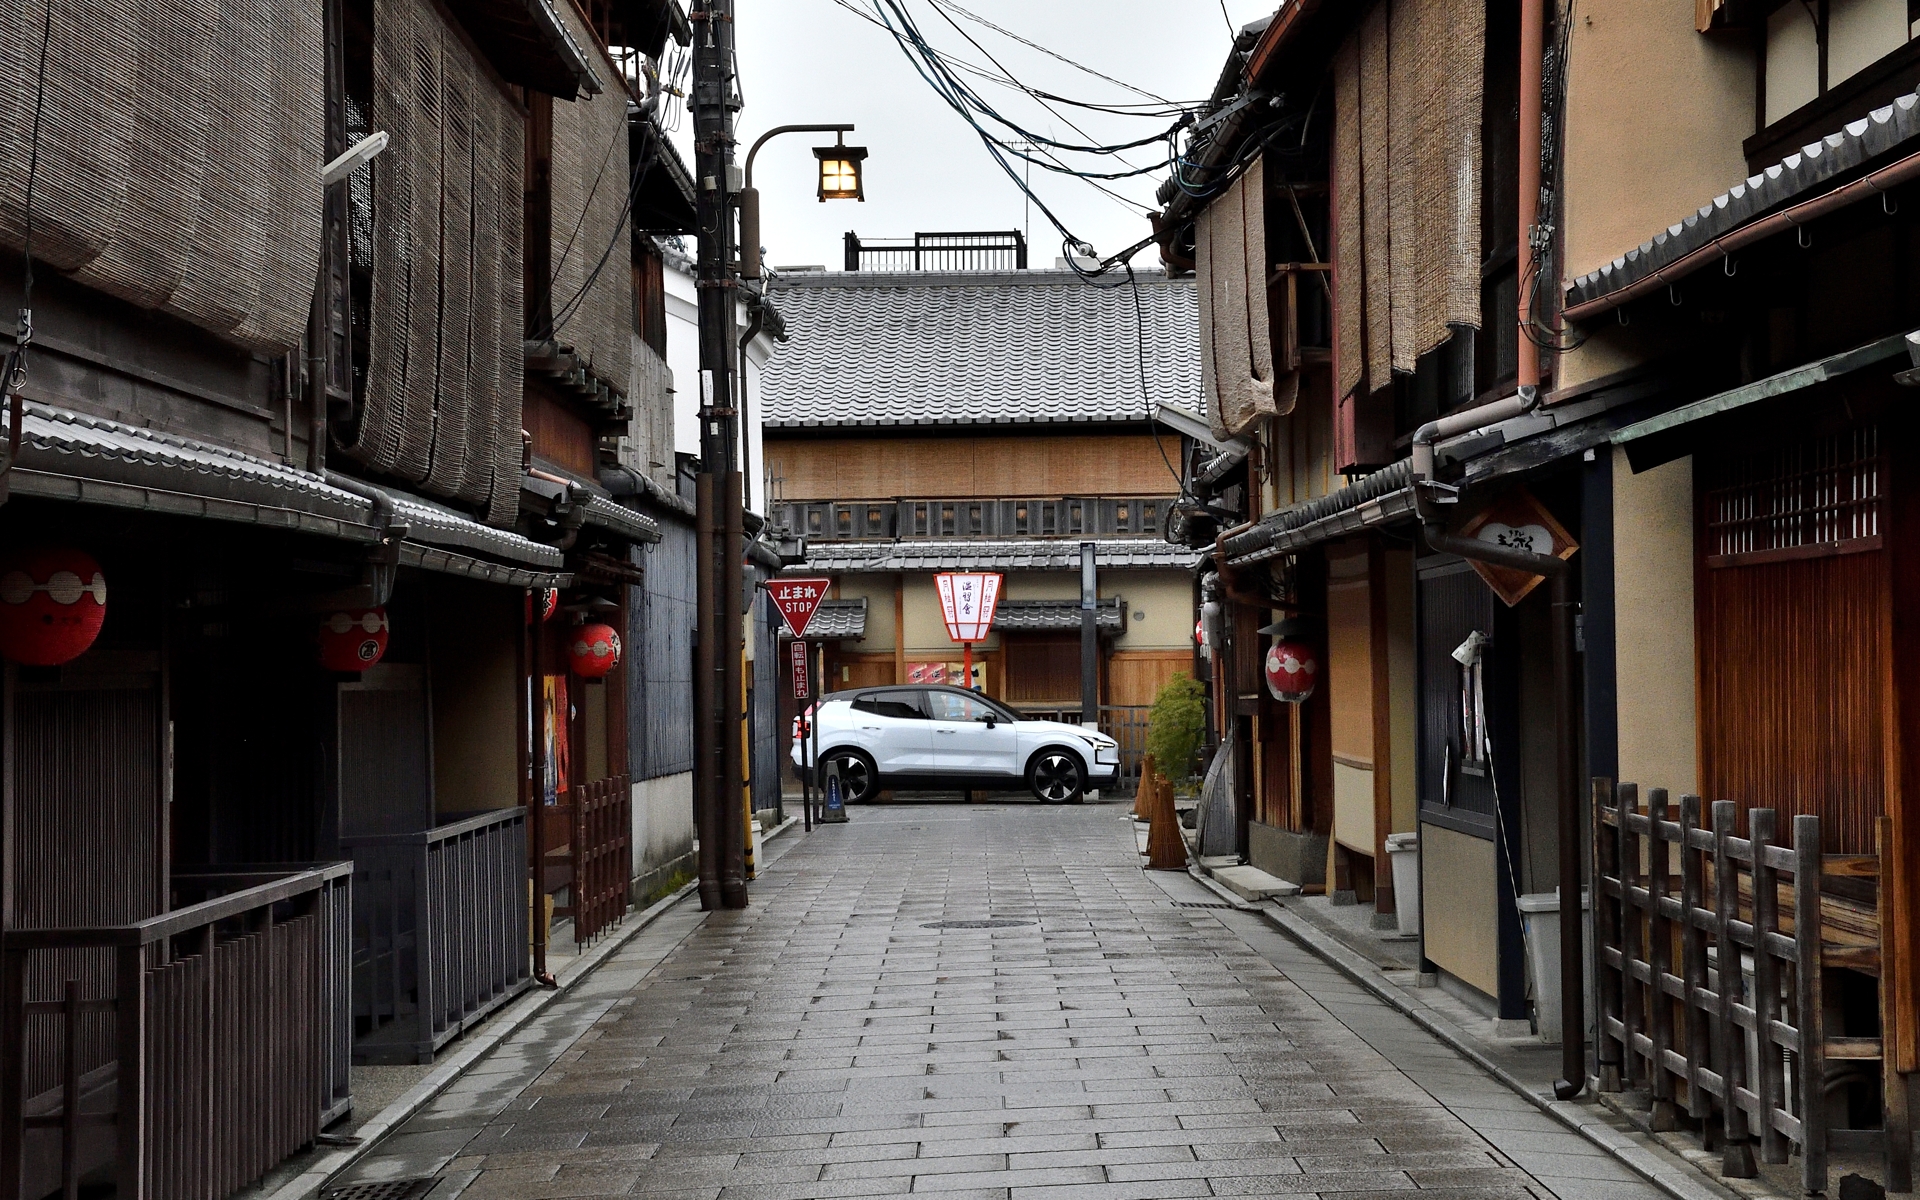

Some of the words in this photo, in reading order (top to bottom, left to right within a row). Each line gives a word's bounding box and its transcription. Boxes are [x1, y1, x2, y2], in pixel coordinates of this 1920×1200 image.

[778, 585, 817, 599] 止まれ
[786, 601, 812, 613] STOP
[793, 644, 808, 697] 自転車も止まれ
